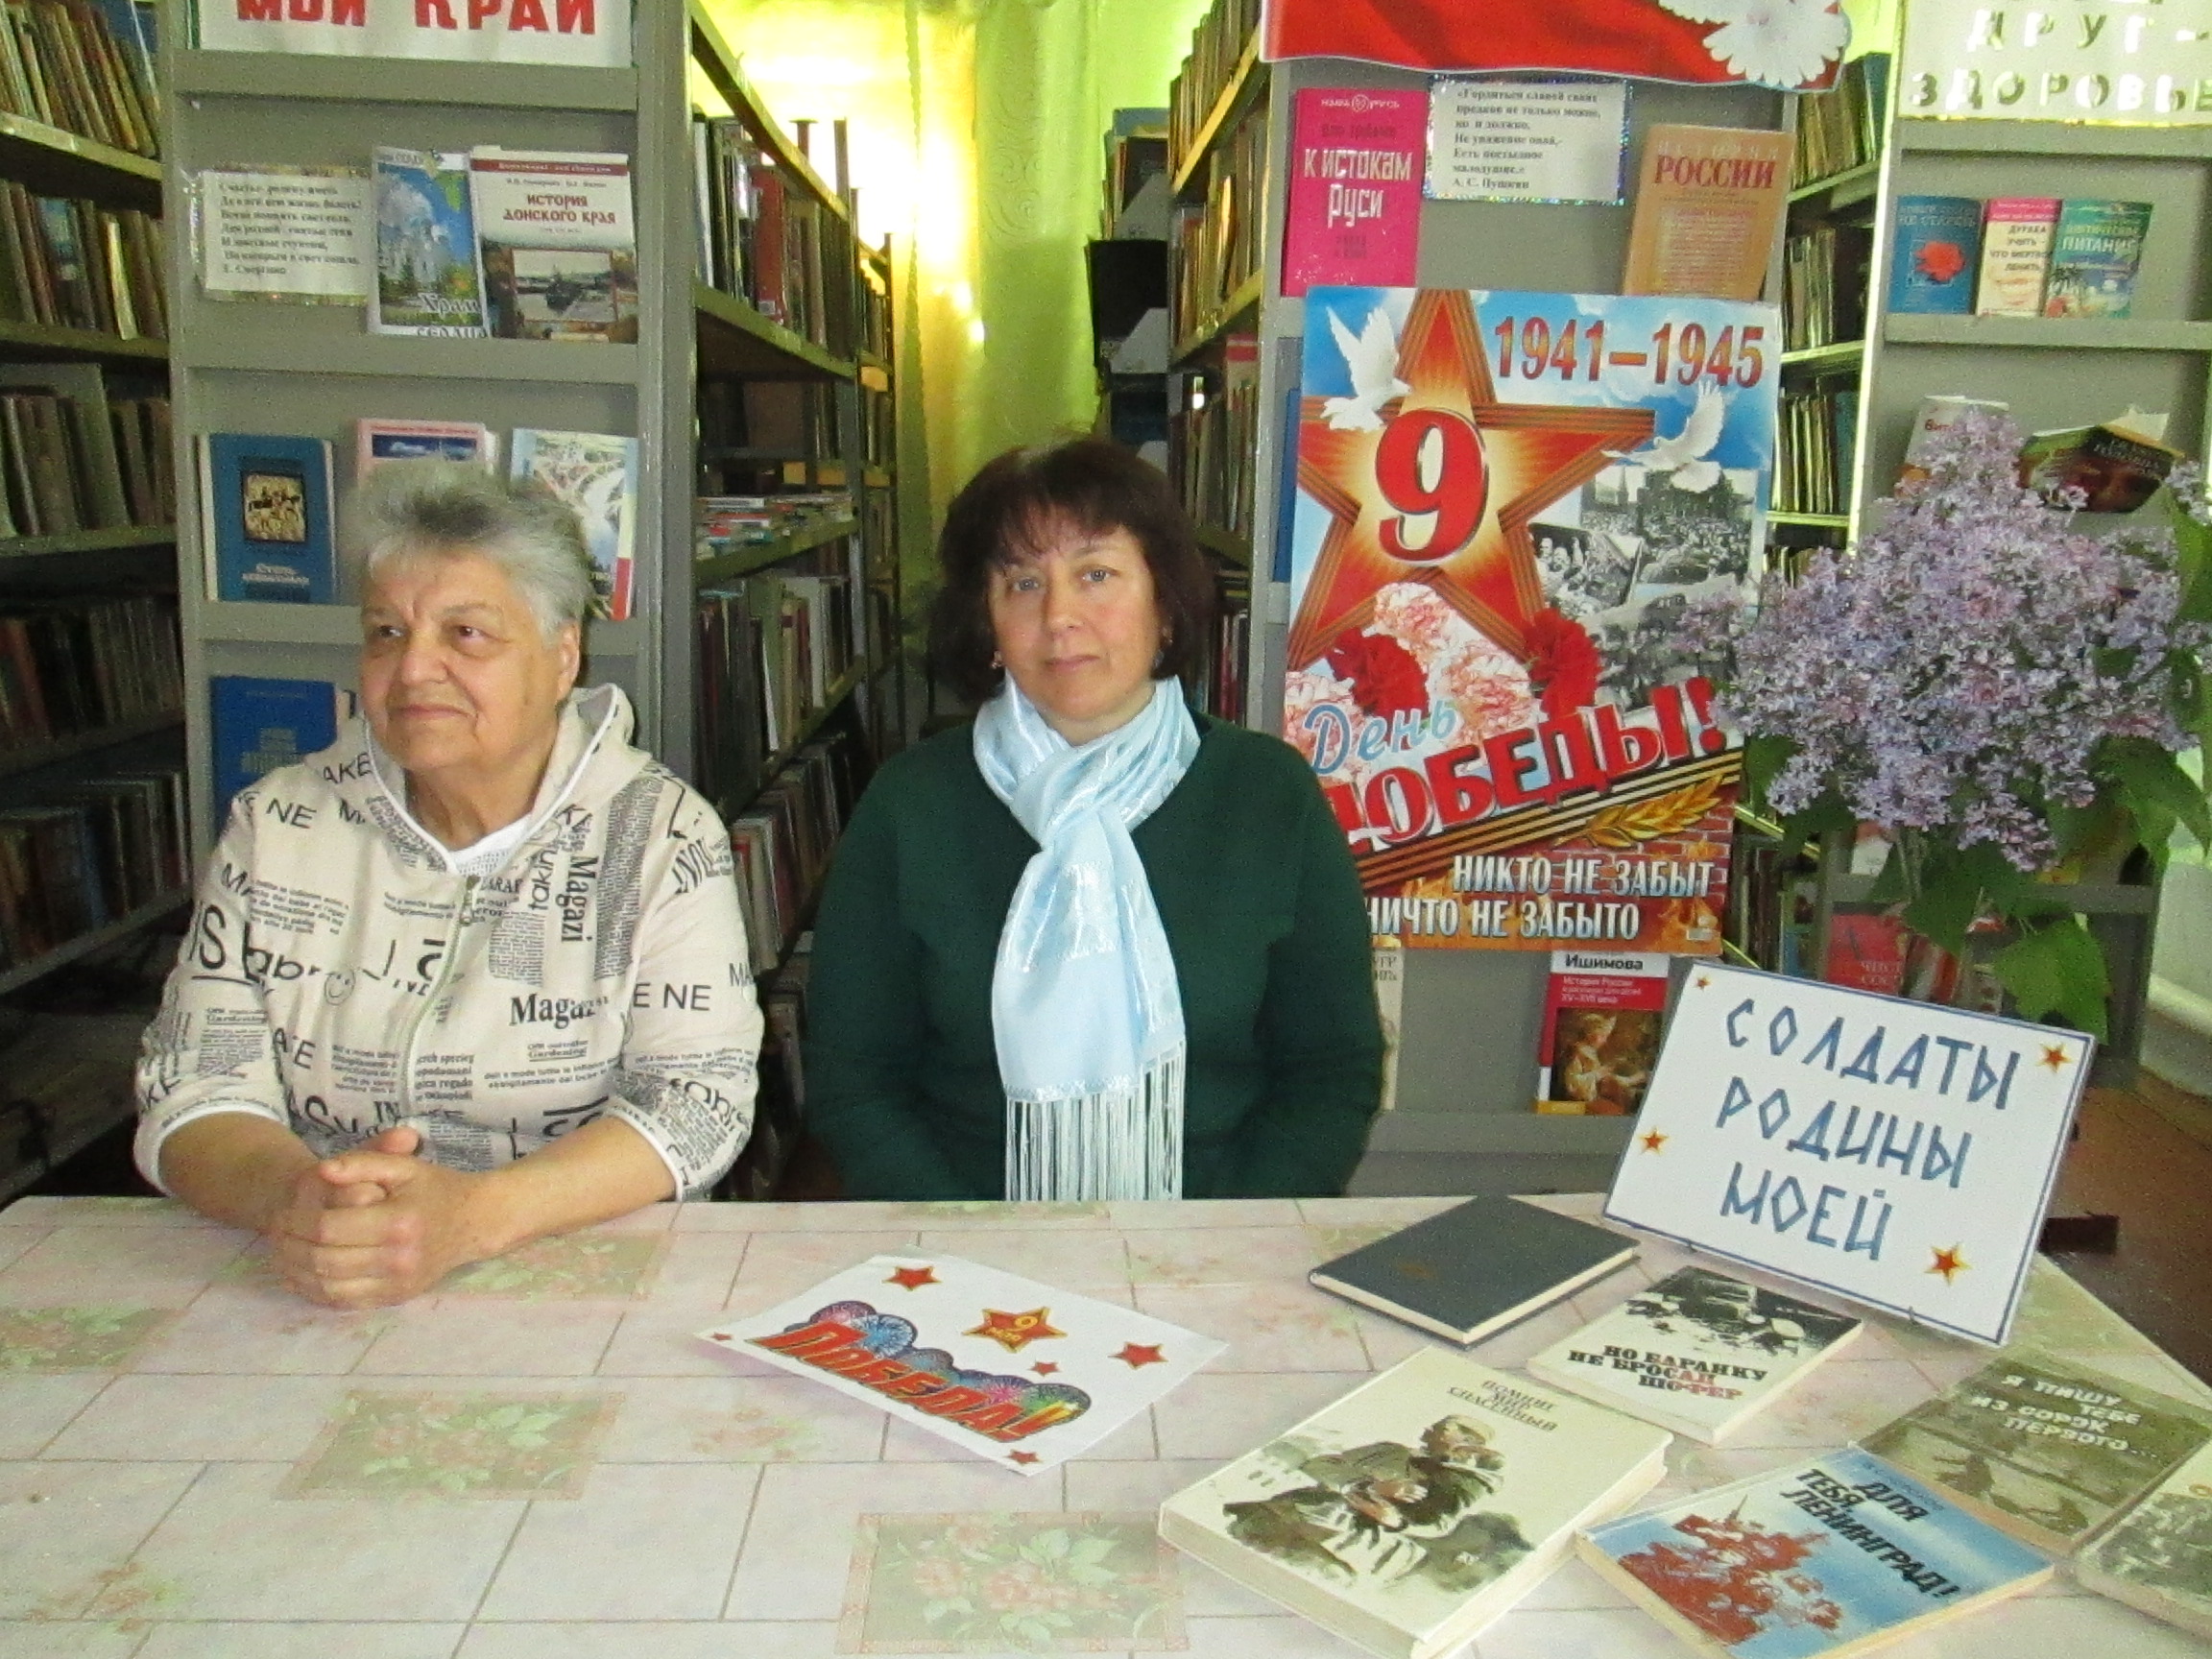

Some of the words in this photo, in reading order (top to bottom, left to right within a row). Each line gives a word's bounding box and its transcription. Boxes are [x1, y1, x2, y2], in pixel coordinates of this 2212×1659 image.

[1653, 155, 1776, 188] РОССИИ
[503, 209, 578, 223] ДОНСКОГО
[582, 210, 616, 227] КРАЯ
[527, 194, 589, 210] ИСТОРИЯ
[1375, 408, 1487, 565] 9
[1304, 698, 1458, 776] День
[1453, 854, 1551, 894] НИКТО
[1565, 857, 1603, 896] НЕ
[1614, 860, 1714, 899] ЗАБЫТ
[1471, 899, 1507, 936] НЕ
[1520, 901, 1641, 940] ЗАБЫТО
[1565, 953, 1644, 971] Ишимова
[1725, 998, 2021, 1111] СОЛДАТЫ
[1716, 1075, 1974, 1189] РОДИНЫ
[1719, 1160, 1893, 1262] МОЕЙ
[1568, 1349, 1605, 1366] НЕ
[1601, 1344, 1639, 1360] НО
[1645, 1352, 1767, 1381] БАРАНКУ
[2001, 1374, 2026, 1389] Я
[2032, 1382, 2123, 1407] ПИШУ
[1970, 1395, 2009, 1413] ИЗ
[2017, 1405, 2110, 1435] СОРОК
[2079, 1404, 2142, 1428] ТЕБЕ
[1853, 1480, 1932, 1525] ДЛЯ
[1779, 1488, 1962, 1599] ЛЕНИНГРАД!
